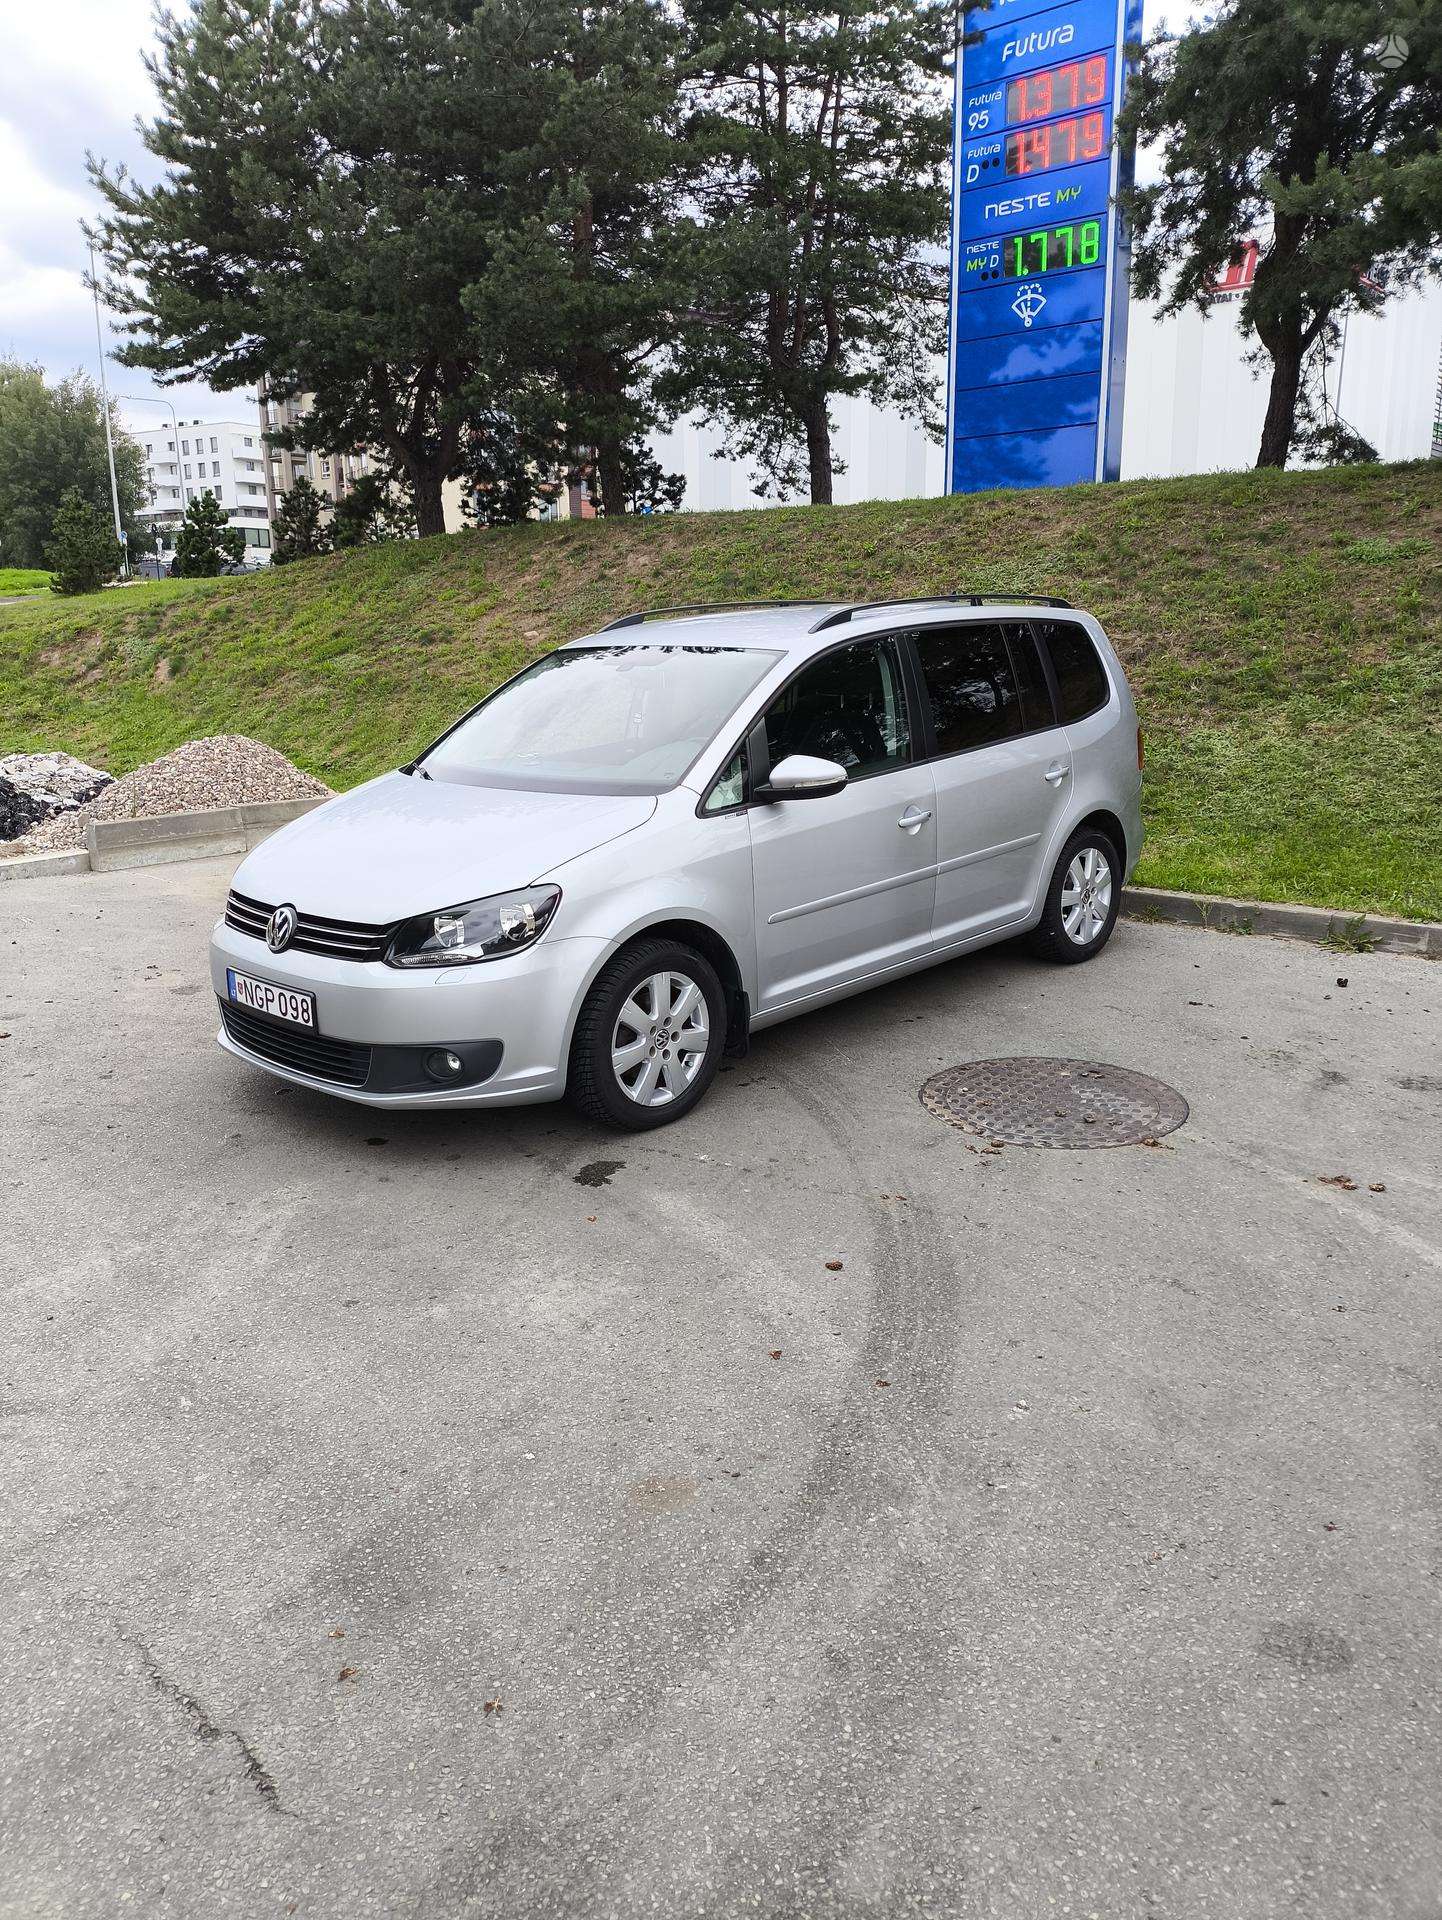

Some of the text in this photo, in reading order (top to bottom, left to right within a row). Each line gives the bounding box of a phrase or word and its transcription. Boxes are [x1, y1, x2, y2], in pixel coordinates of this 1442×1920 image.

[1001, 24, 1075, 62] Futura
[968, 89, 1003, 108] Futura
[968, 110, 989, 131] 95
[967, 142, 1001, 160] Futura
[966, 164, 980, 184] D
[984, 185, 1082, 220] NESTE MY
[966, 241, 1000, 255] NESTE
[1013, 221, 1100, 277] 1.778
[966, 254, 999, 272] MY D
